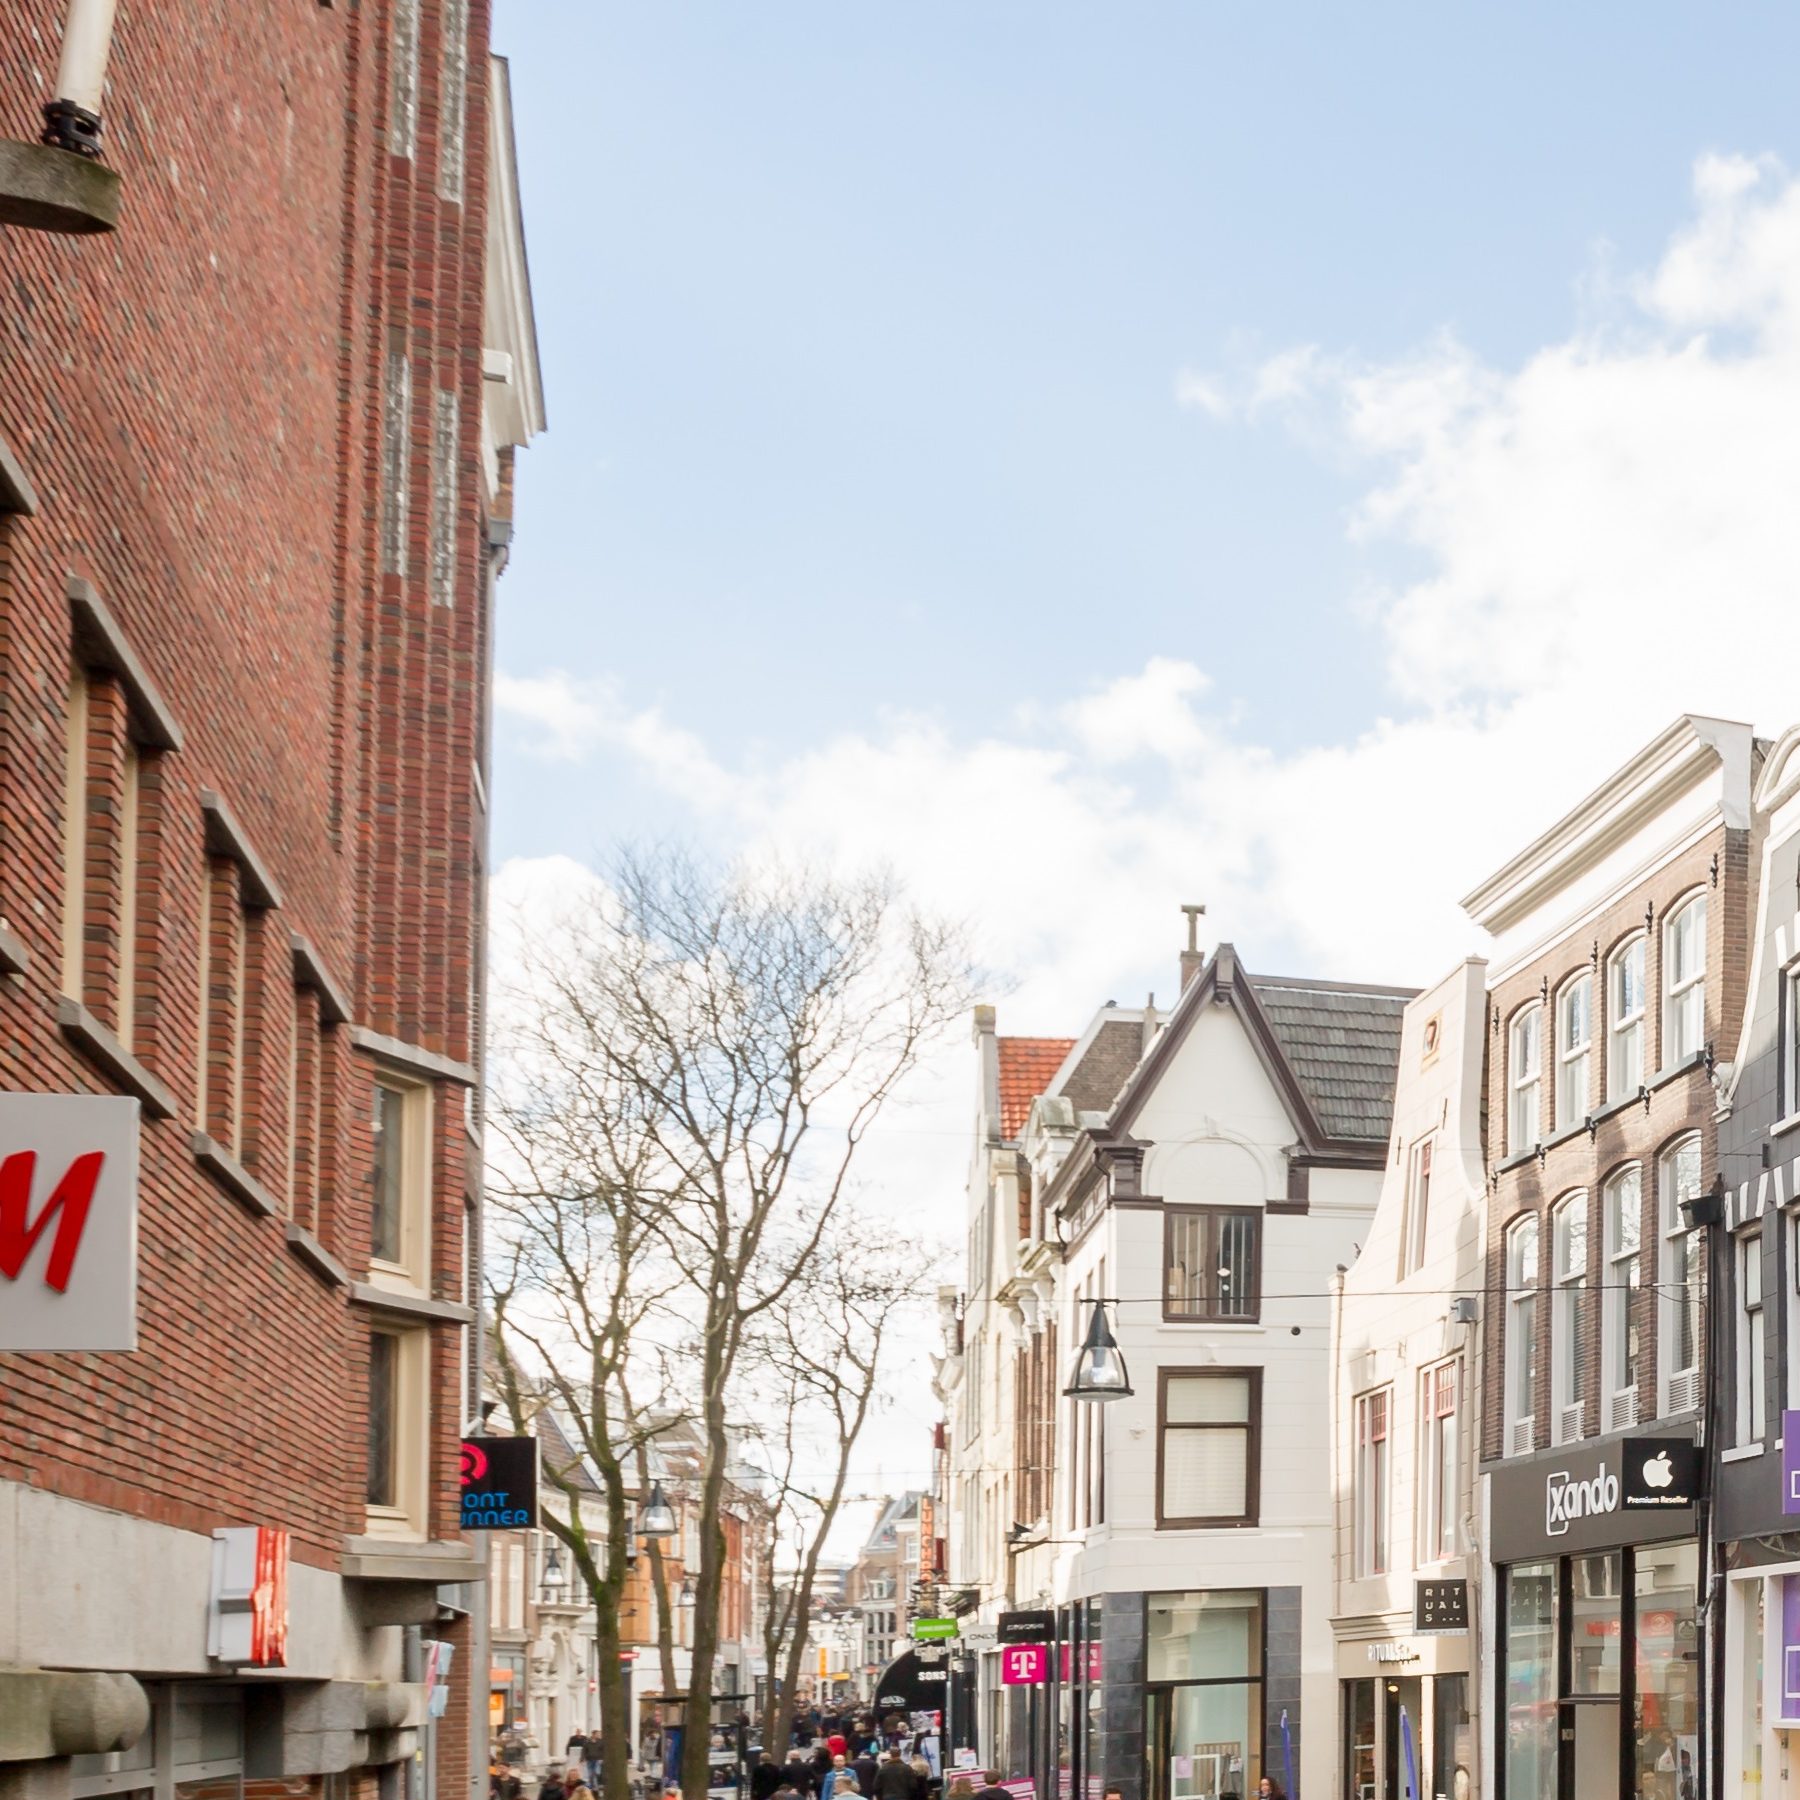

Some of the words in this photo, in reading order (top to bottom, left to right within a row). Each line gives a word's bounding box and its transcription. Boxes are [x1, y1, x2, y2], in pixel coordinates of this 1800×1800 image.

[463, 1492, 510, 1508] ONT
[1627, 1496, 1660, 1504] Premium
[1660, 1495, 1688, 1504] Reseller
